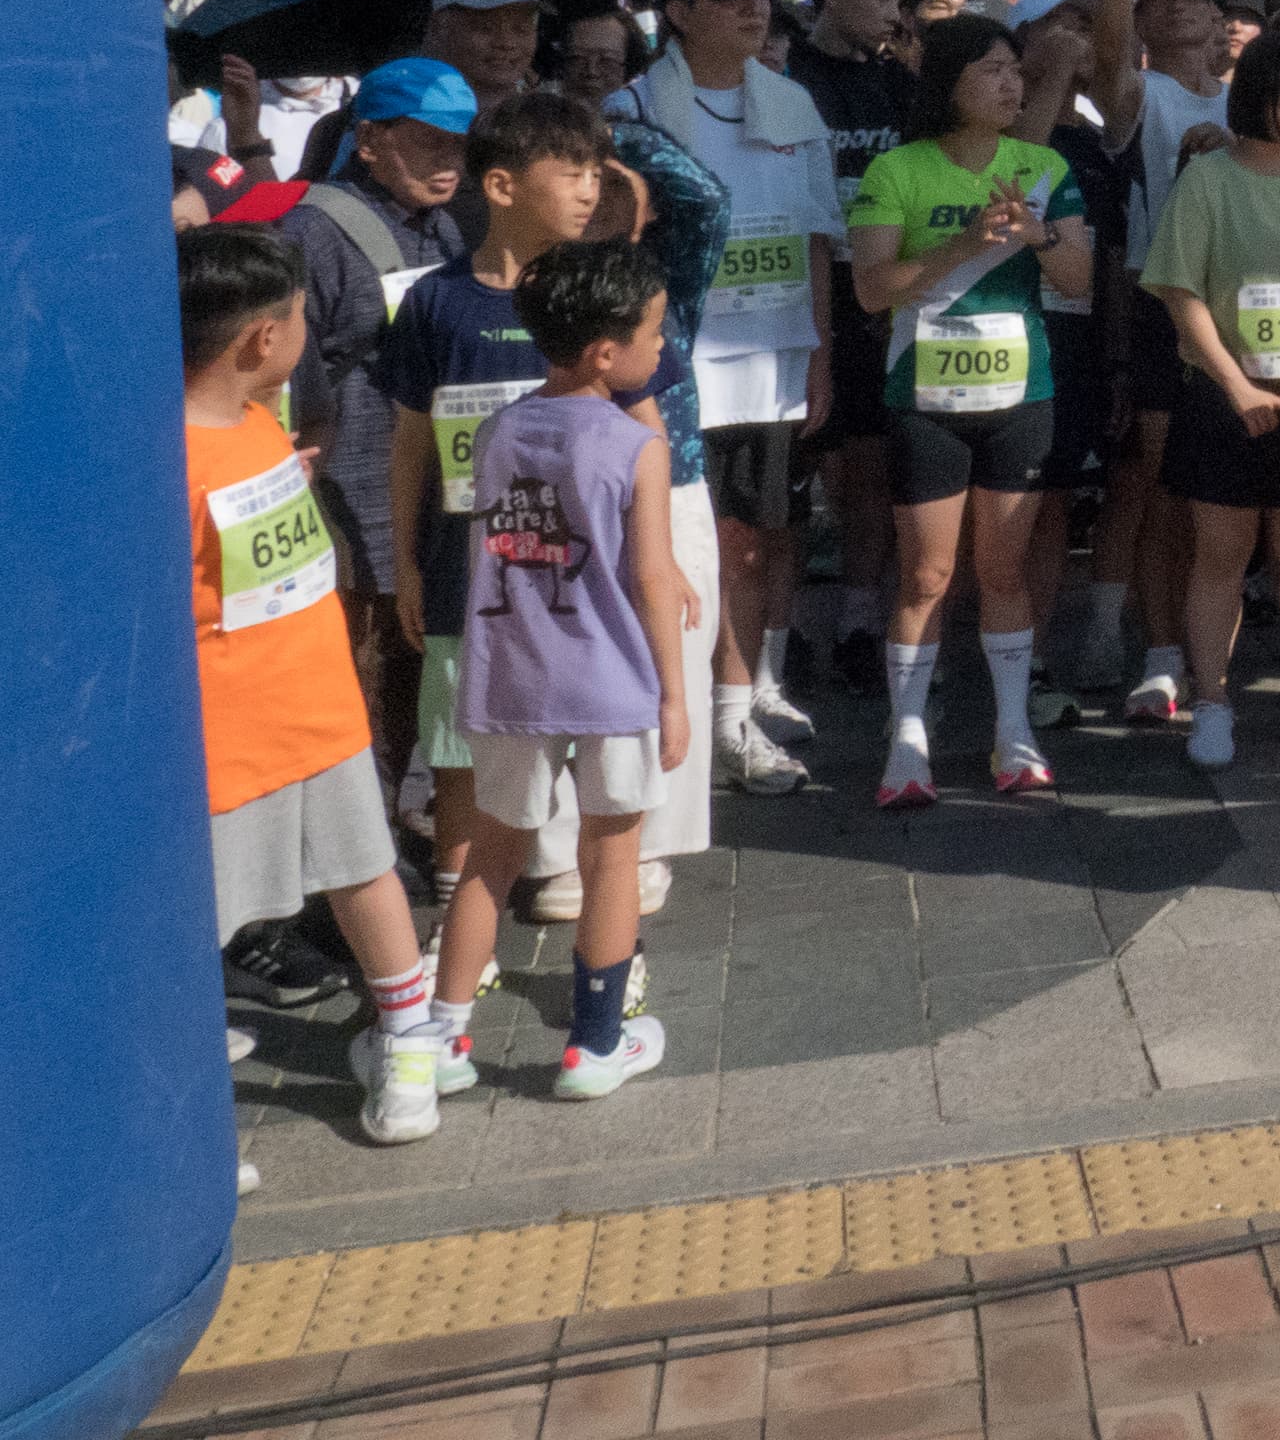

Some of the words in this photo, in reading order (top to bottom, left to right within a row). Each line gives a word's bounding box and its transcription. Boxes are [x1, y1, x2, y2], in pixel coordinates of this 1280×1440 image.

[929, 205, 982, 228] BW
[723, 245, 791, 276] 5955
[936, 348, 1010, 377] 7008
[452, 430, 471, 461] 6
[252, 504, 320, 568] 6544
